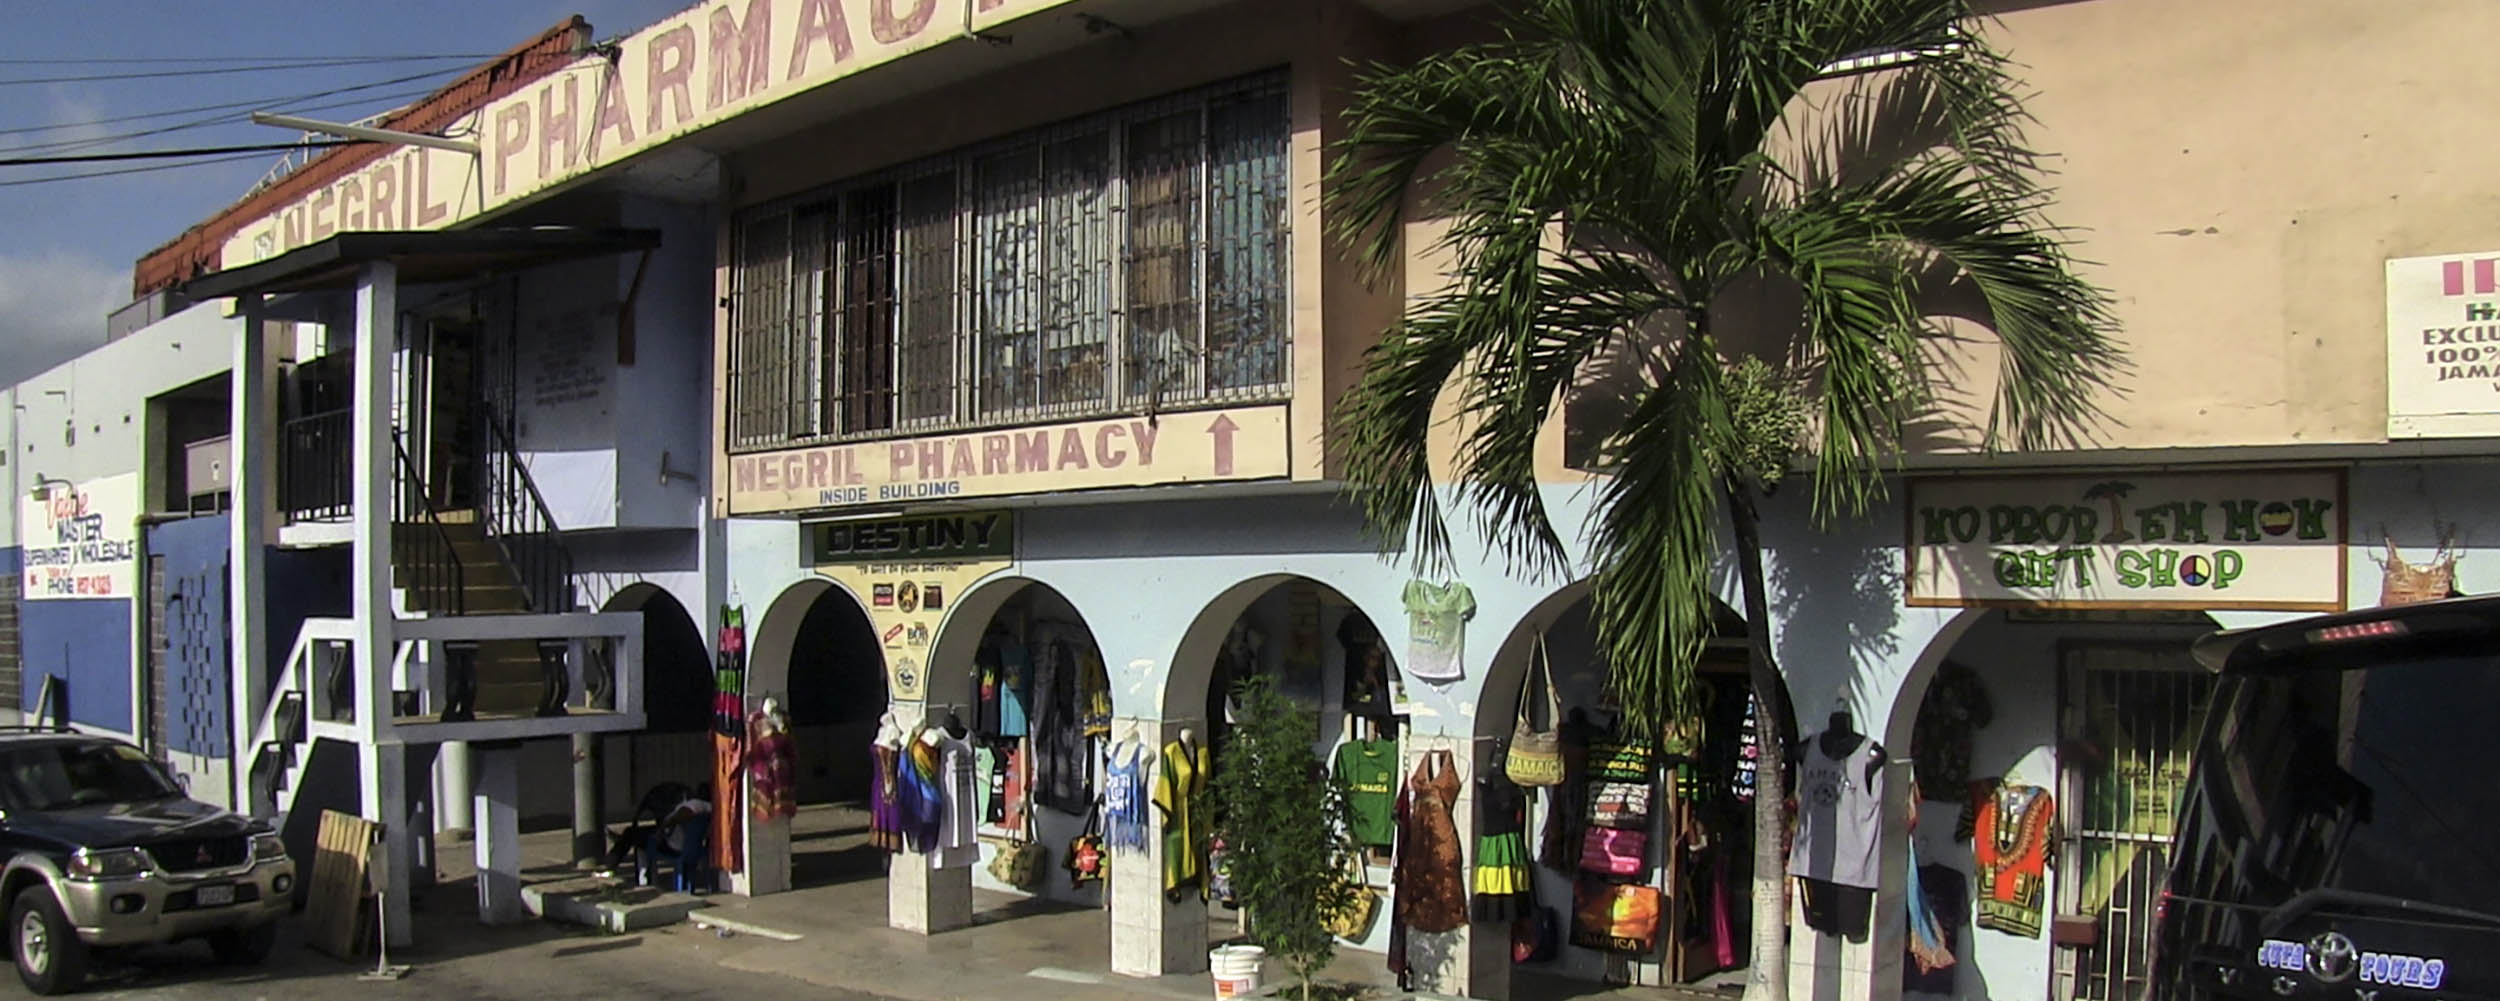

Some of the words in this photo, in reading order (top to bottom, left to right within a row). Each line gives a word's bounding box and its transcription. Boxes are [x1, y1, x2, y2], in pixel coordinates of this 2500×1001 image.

[284, 146, 447, 251] NEGRIL
[495, 0, 1004, 196] PHARMA
[736, 446, 864, 492] NEGRIL
[890, 419, 1160, 482] PHARMACY
[820, 487, 867, 505] INSIDE
[879, 480, 960, 500] BUILDING
[57, 513, 103, 543] MASTER
[827, 513, 999, 555] DESTINY
[1920, 505, 1981, 546] NO
[48, 577, 74, 596] PHONE
[1994, 547, 2095, 588] GIFT
[2115, 548, 2244, 590] SHOP
[2360, 952, 2444, 989] TOURS
